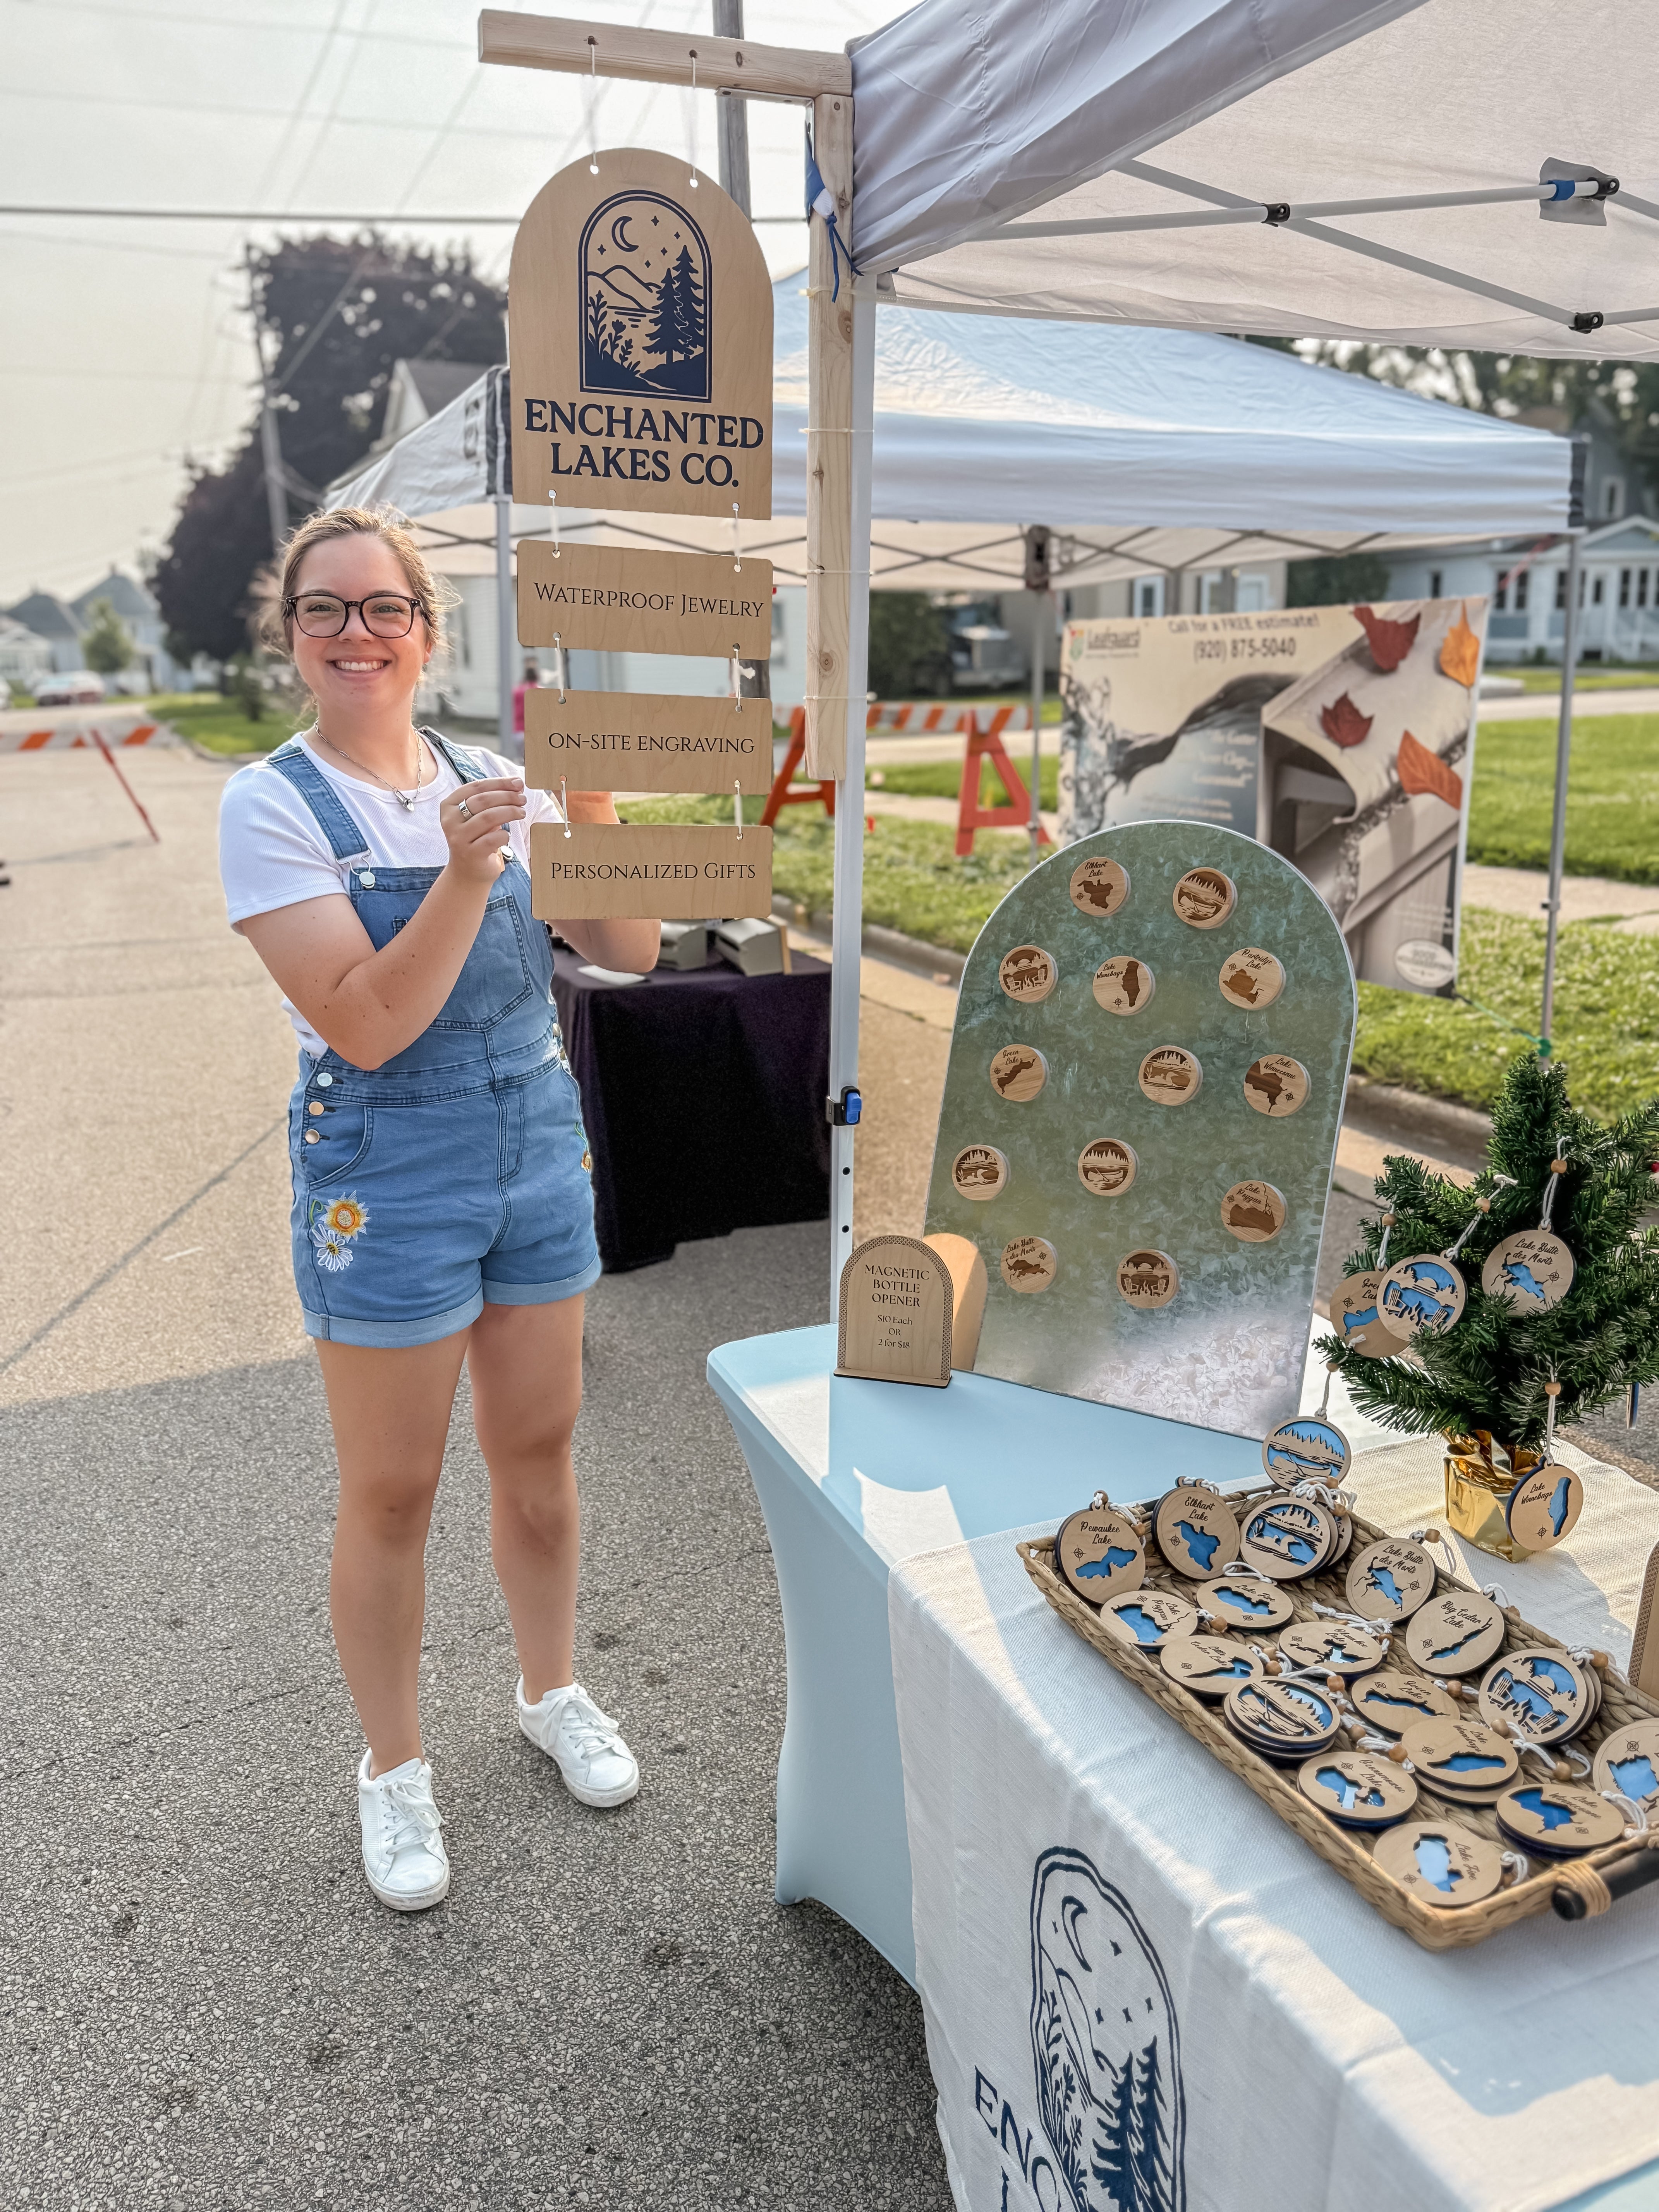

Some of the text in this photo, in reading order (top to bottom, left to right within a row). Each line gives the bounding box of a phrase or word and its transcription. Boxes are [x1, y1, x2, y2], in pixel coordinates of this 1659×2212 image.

[524, 399, 763, 448] ENCHANTED
[551, 442, 738, 487] LAKES CO.
[1194, 637, 1296, 664] (920) 875-5040
[548, 732, 755, 753] ON-SITE ENGRAVING
[1085, 861, 1108, 870] Elkhart
[1242, 949, 1272, 965] Partridge
[1245, 960, 1261, 970] Lake
[1097, 971, 1123, 979] Winnebago
[1005, 1056, 1018, 1065] Lake
[1275, 1058, 1291, 1068] Lake
[1264, 1061, 1296, 1079] Winneconne
[1244, 1183, 1260, 1194] Lake
[1237, 1188, 1261, 1204] Poygan
[1006, 1238, 1034, 1253] Lake Butte
[1020, 1245, 1035, 1256] Morts
[1514, 1238, 1559, 1255] Lake Butte
[1513, 1250, 1553, 1265] des Morts
[865, 1264, 929, 1280] MAGNETIC
[873, 1279, 920, 1293] BOTTLE
[872, 1293, 920, 1307] OPENER
[878, 1315, 912, 1325] $10 Each
[884, 1339, 896, 1348] for
[898, 1340, 910, 1349] $18
[1530, 1482, 1545, 1493] Lake
[1185, 1496, 1216, 1511] Elkhart
[1521, 1491, 1553, 1504] Winnebago
[1188, 1509, 1208, 1521] Lake
[1081, 1521, 1120, 1532] Pewaukee
[1092, 1534, 1112, 1544] Lake
[1382, 1544, 1423, 1565] Lake Butte
[1379, 1556, 1416, 1574] des Morts
[1235, 1585, 1256, 1594] Lake
[1152, 1600, 1168, 1620] Poygan
[1165, 1602, 1180, 1615] Lake
[1441, 1601, 1481, 1623] Big Cedar
[1443, 1615, 1464, 1628] Lake
[1325, 1633, 1345, 1642] Lake
[1190, 1641, 1227, 1666] Cedar Lake
[1207, 1646, 1226, 1656] Little
[1398, 1687, 1423, 1699] Lake
[1404, 1681, 1431, 1695] Green
[1453, 1725, 1482, 1752] Winnebago
[1470, 1730, 1488, 1744] Lake
[1359, 1760, 1405, 1793] Oconomowoc
[1359, 1773, 1382, 1787] Lake
[1549, 1793, 1602, 1819] Winneconne
[1570, 1796, 1598, 1808] Lake
[1455, 1842, 1473, 1862] Lake
